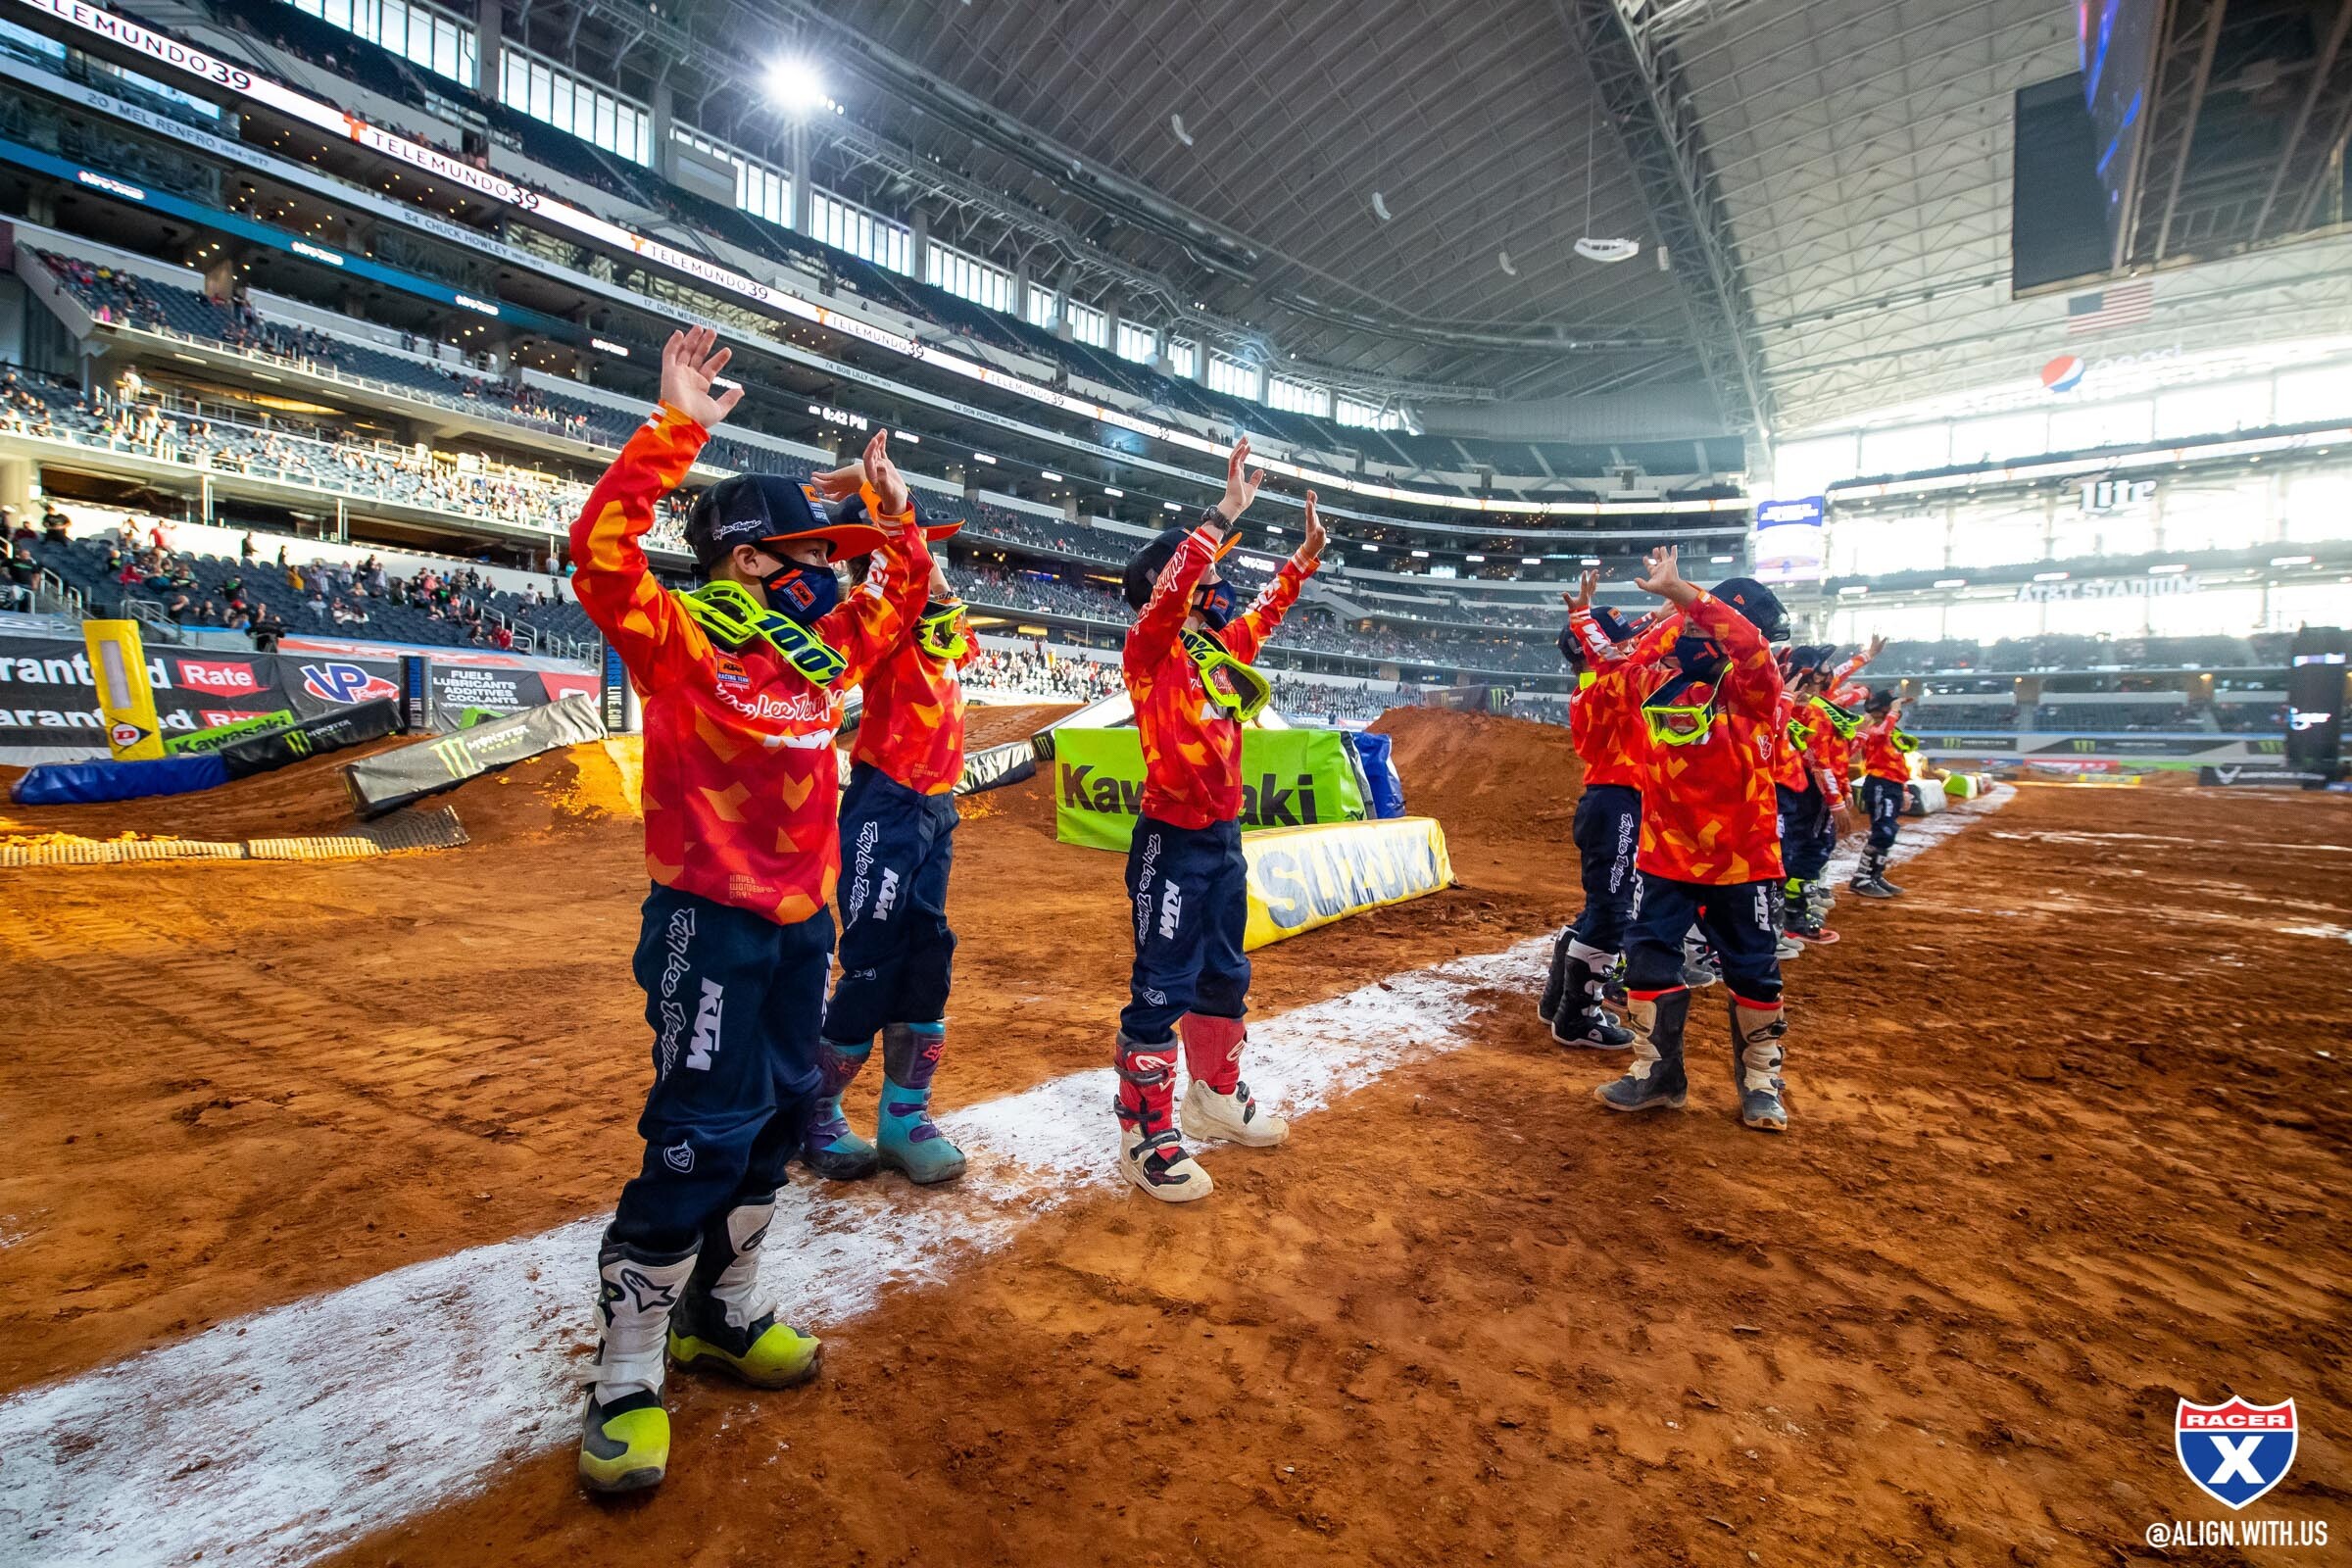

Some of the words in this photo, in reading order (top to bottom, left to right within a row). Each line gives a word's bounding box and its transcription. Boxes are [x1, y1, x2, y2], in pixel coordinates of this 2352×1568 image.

[32, 0, 252, 91] LEMUNDO39
[86, 91, 109, 109] 20
[118, 103, 150, 124] MEL
[155, 117, 216, 149] RENFRO
[373, 131, 539, 210] TELEMUNDO39
[404, 211, 418, 224] 54
[424, 218, 461, 239] CHUCK
[464, 232, 508, 256] HOWLEY
[651, 245, 768, 300] TELEMUNDO39
[644, 298, 652, 307] 17
[657, 303, 674, 315] DON
[677, 310, 716, 329] MEREDITH
[833, 316, 924, 360] TELEMUNDO39
[836, 365, 851, 375] BOB
[852, 369, 868, 381] LILLY
[991, 373, 1064, 406] TELEMUNDO39
[849, 415, 868, 432] PM
[0, 653, 173, 689] rantd
[183, 664, 252, 687] Rate
[299, 662, 368, 705] VP
[432, 677, 517, 690] LUBRICANTS
[451, 670, 493, 680] FUELS
[723, 662, 743, 673] KTM
[444, 686, 514, 697] ADDITIVES
[446, 694, 518, 705] COOLANTS
[757, 694, 795, 720] Lee
[173, 715, 286, 753] Kawasaki
[1061, 762, 1319, 827] Kaaki
[856, 821, 878, 854] Troy
[1143, 833, 1161, 864] Troy
[856, 851, 874, 875] Lee
[1140, 863, 1156, 892] Lee
[1256, 834, 1441, 929] SUZUKI
[1158, 878, 1182, 940] KTM
[666, 907, 696, 954] Troy
[662, 953, 690, 999] Lee
[686, 976, 724, 1072] KTM
